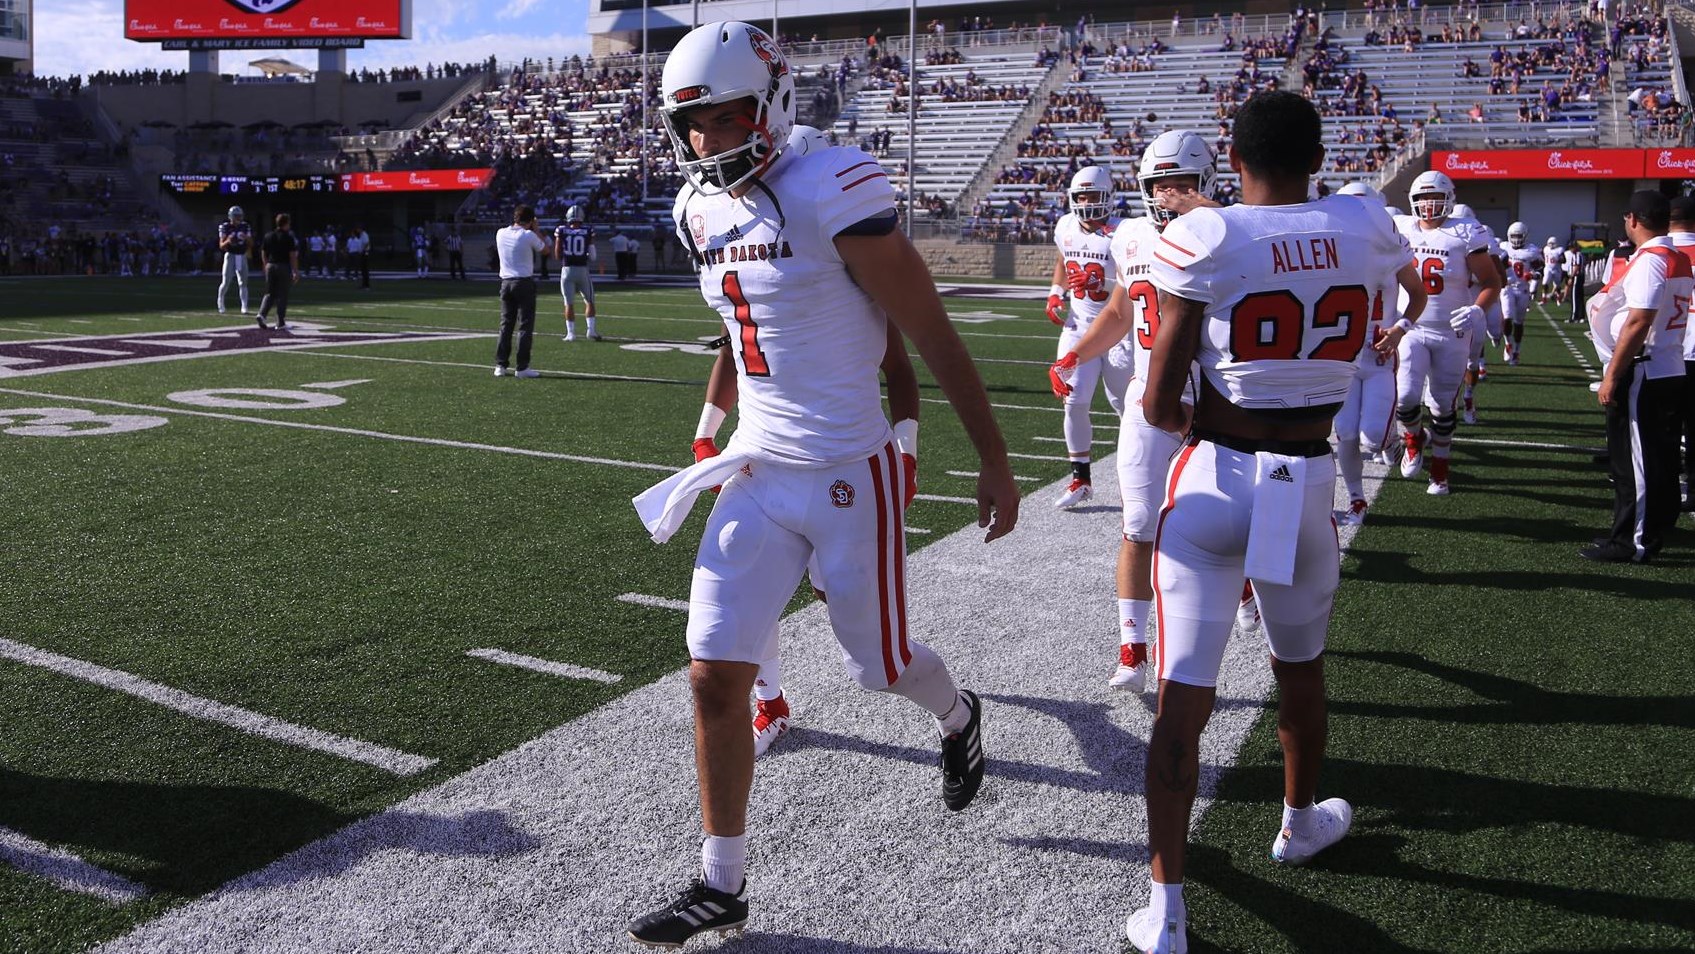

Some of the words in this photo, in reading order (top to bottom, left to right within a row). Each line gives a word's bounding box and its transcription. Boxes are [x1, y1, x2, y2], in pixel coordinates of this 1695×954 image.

[203, 39, 230, 48] MARY
[252, 39, 287, 47] FAMILY
[325, 38, 360, 46] BOARD
[230, 183, 238, 192] 0
[563, 236, 585, 256] 10
[730, 241, 793, 262] DAKOTA
[1272, 238, 1339, 274] ALLEN
[722, 271, 770, 377] 1
